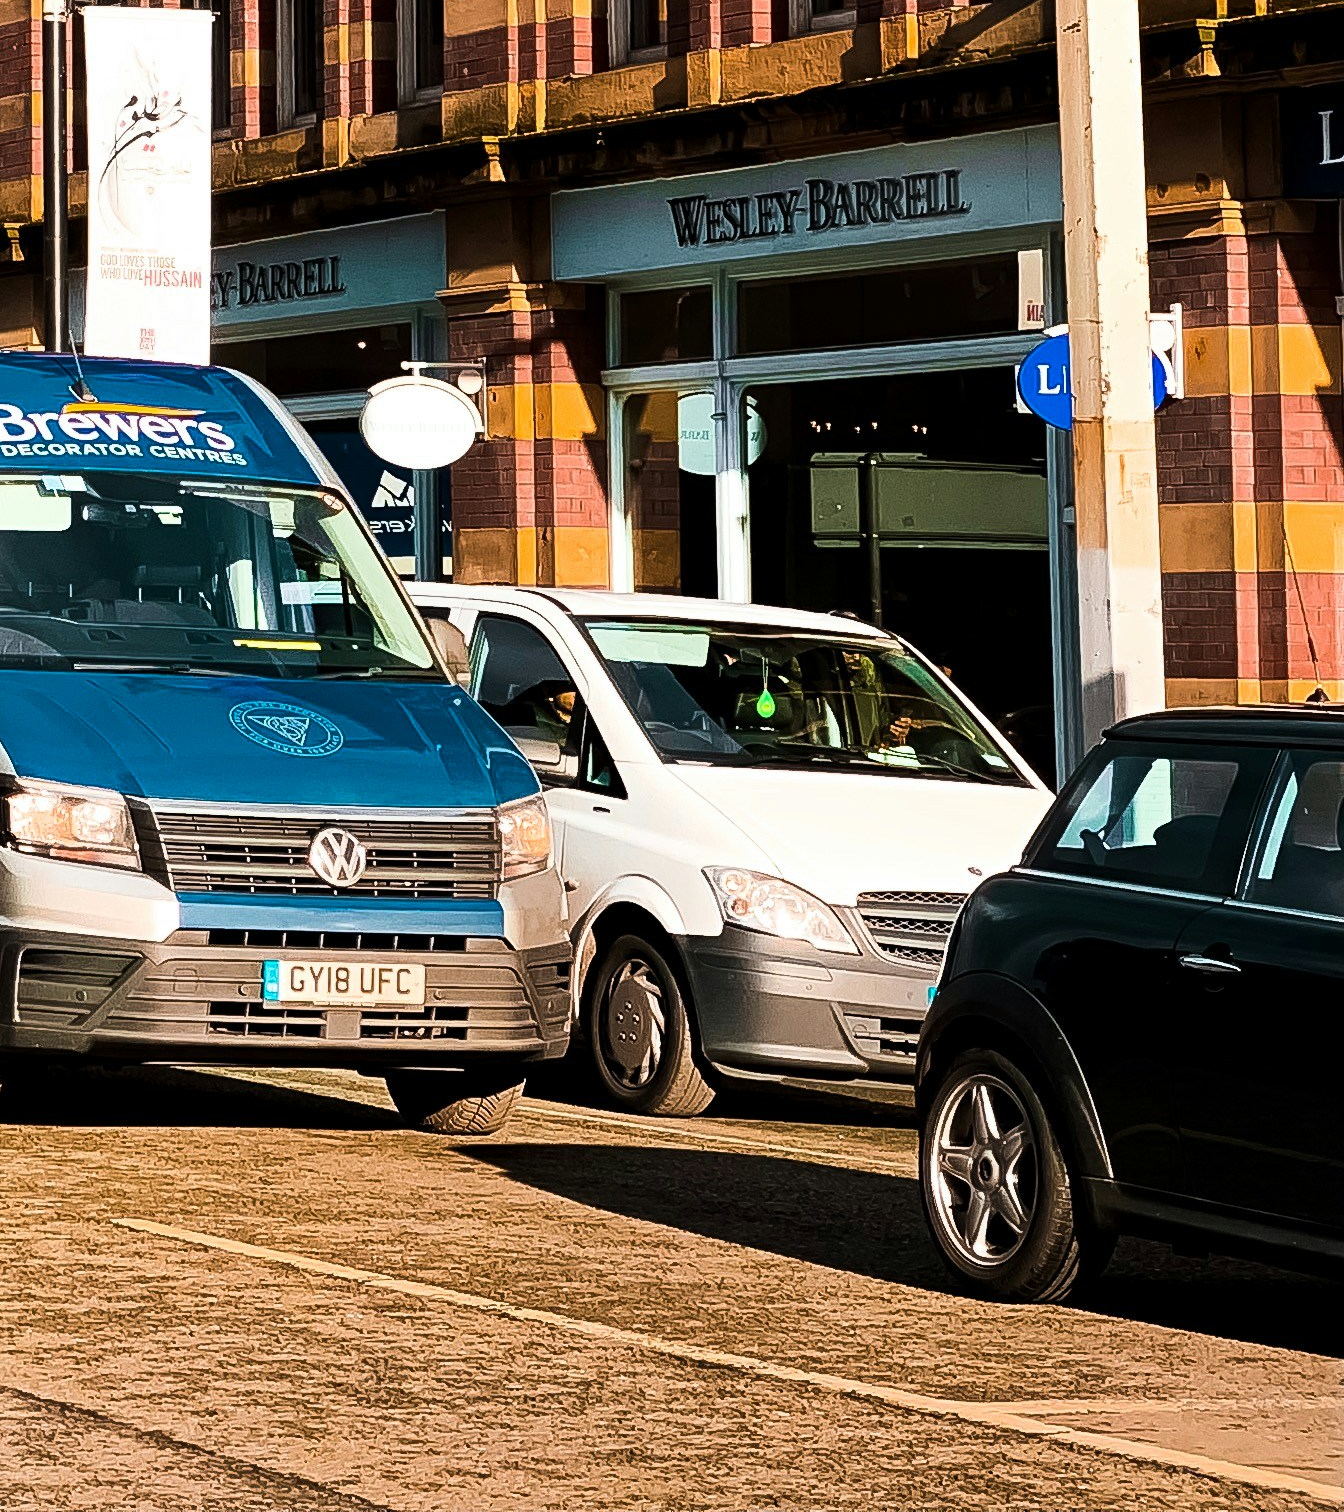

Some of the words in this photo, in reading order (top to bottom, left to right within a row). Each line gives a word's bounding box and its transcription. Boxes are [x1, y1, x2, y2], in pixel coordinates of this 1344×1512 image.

[148, 256, 176, 269] THOSE
[123, 268, 143, 280] LOVE
[144, 269, 202, 288] HUSSAIN
[1037, 364, 1067, 394] L
[0, 443, 144, 457] DECORATOR
[149, 445, 248, 466] CENTRES
[290, 965, 350, 994] GY18
[360, 967, 411, 995] UFC
